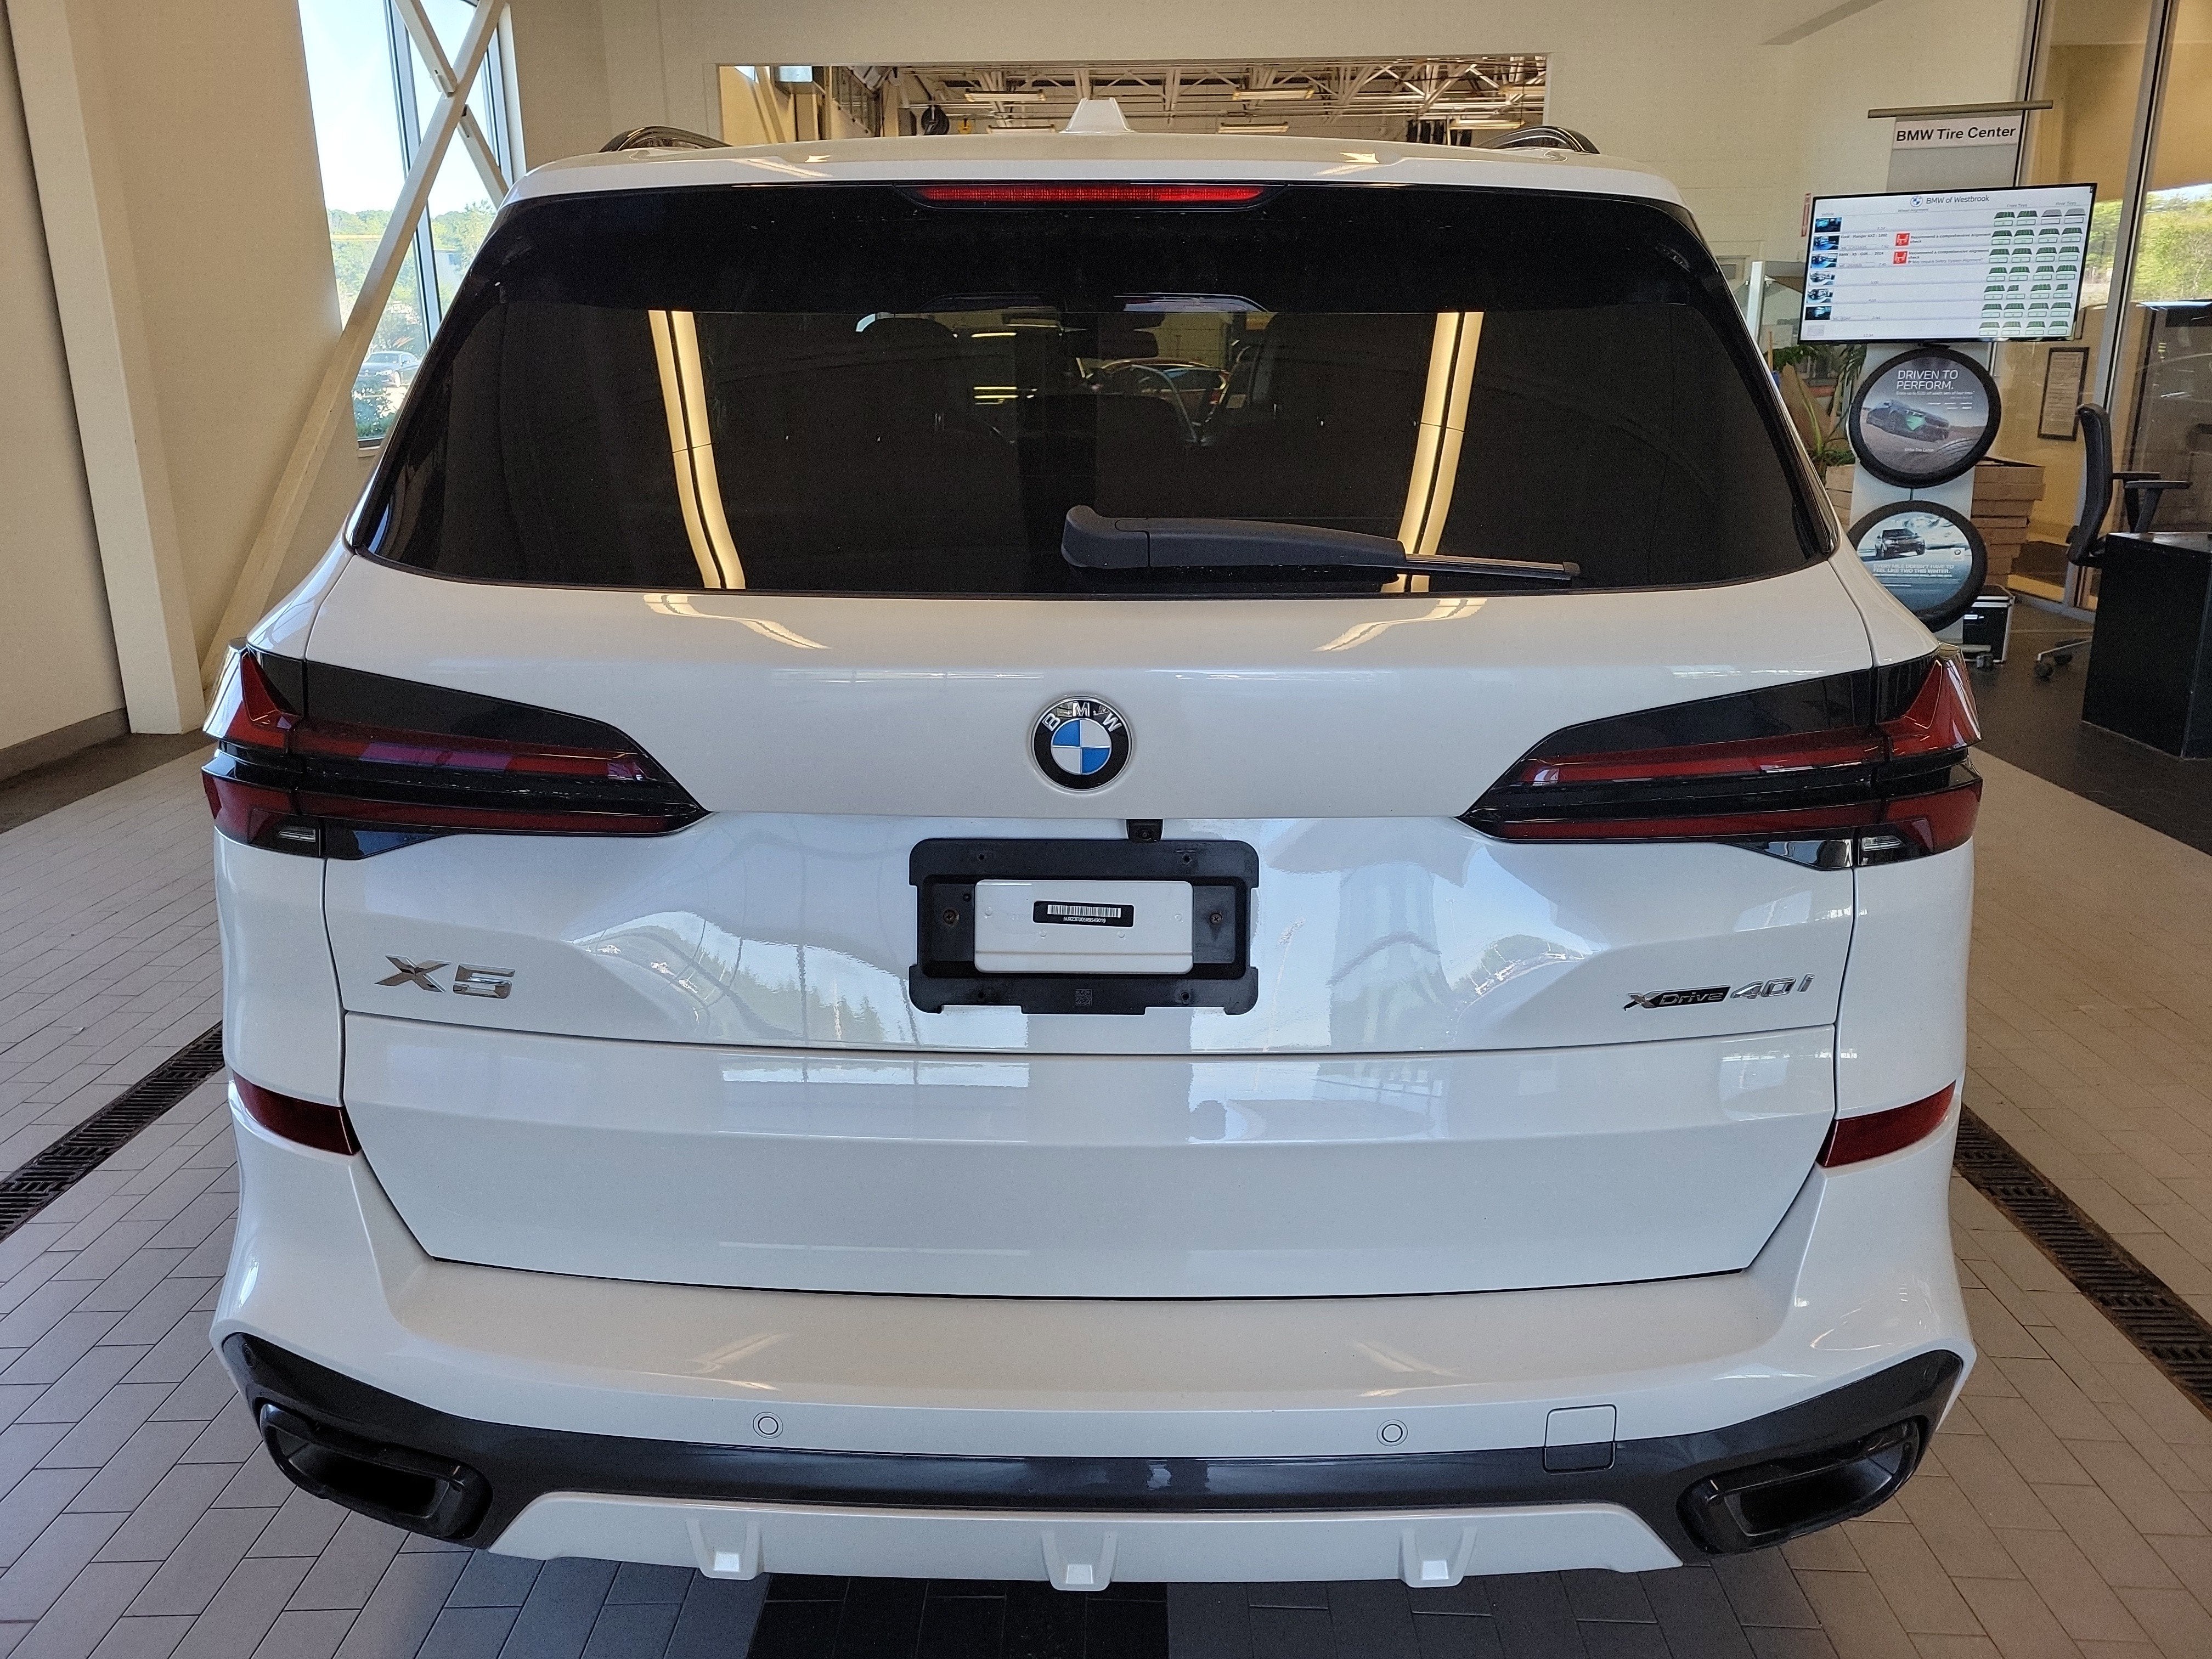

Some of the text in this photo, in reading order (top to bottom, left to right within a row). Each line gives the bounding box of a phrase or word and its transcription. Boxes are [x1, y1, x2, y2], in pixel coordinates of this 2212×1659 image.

[1897, 126, 2017, 142] BMW Tire Center
[1954, 195, 1990, 203] Westbrook
[1898, 370, 1959, 380] DRIVEN TO
[1897, 380, 1954, 390] PERFORM.
[1042, 701, 1122, 732] BMW
[374, 953, 516, 1000] X5
